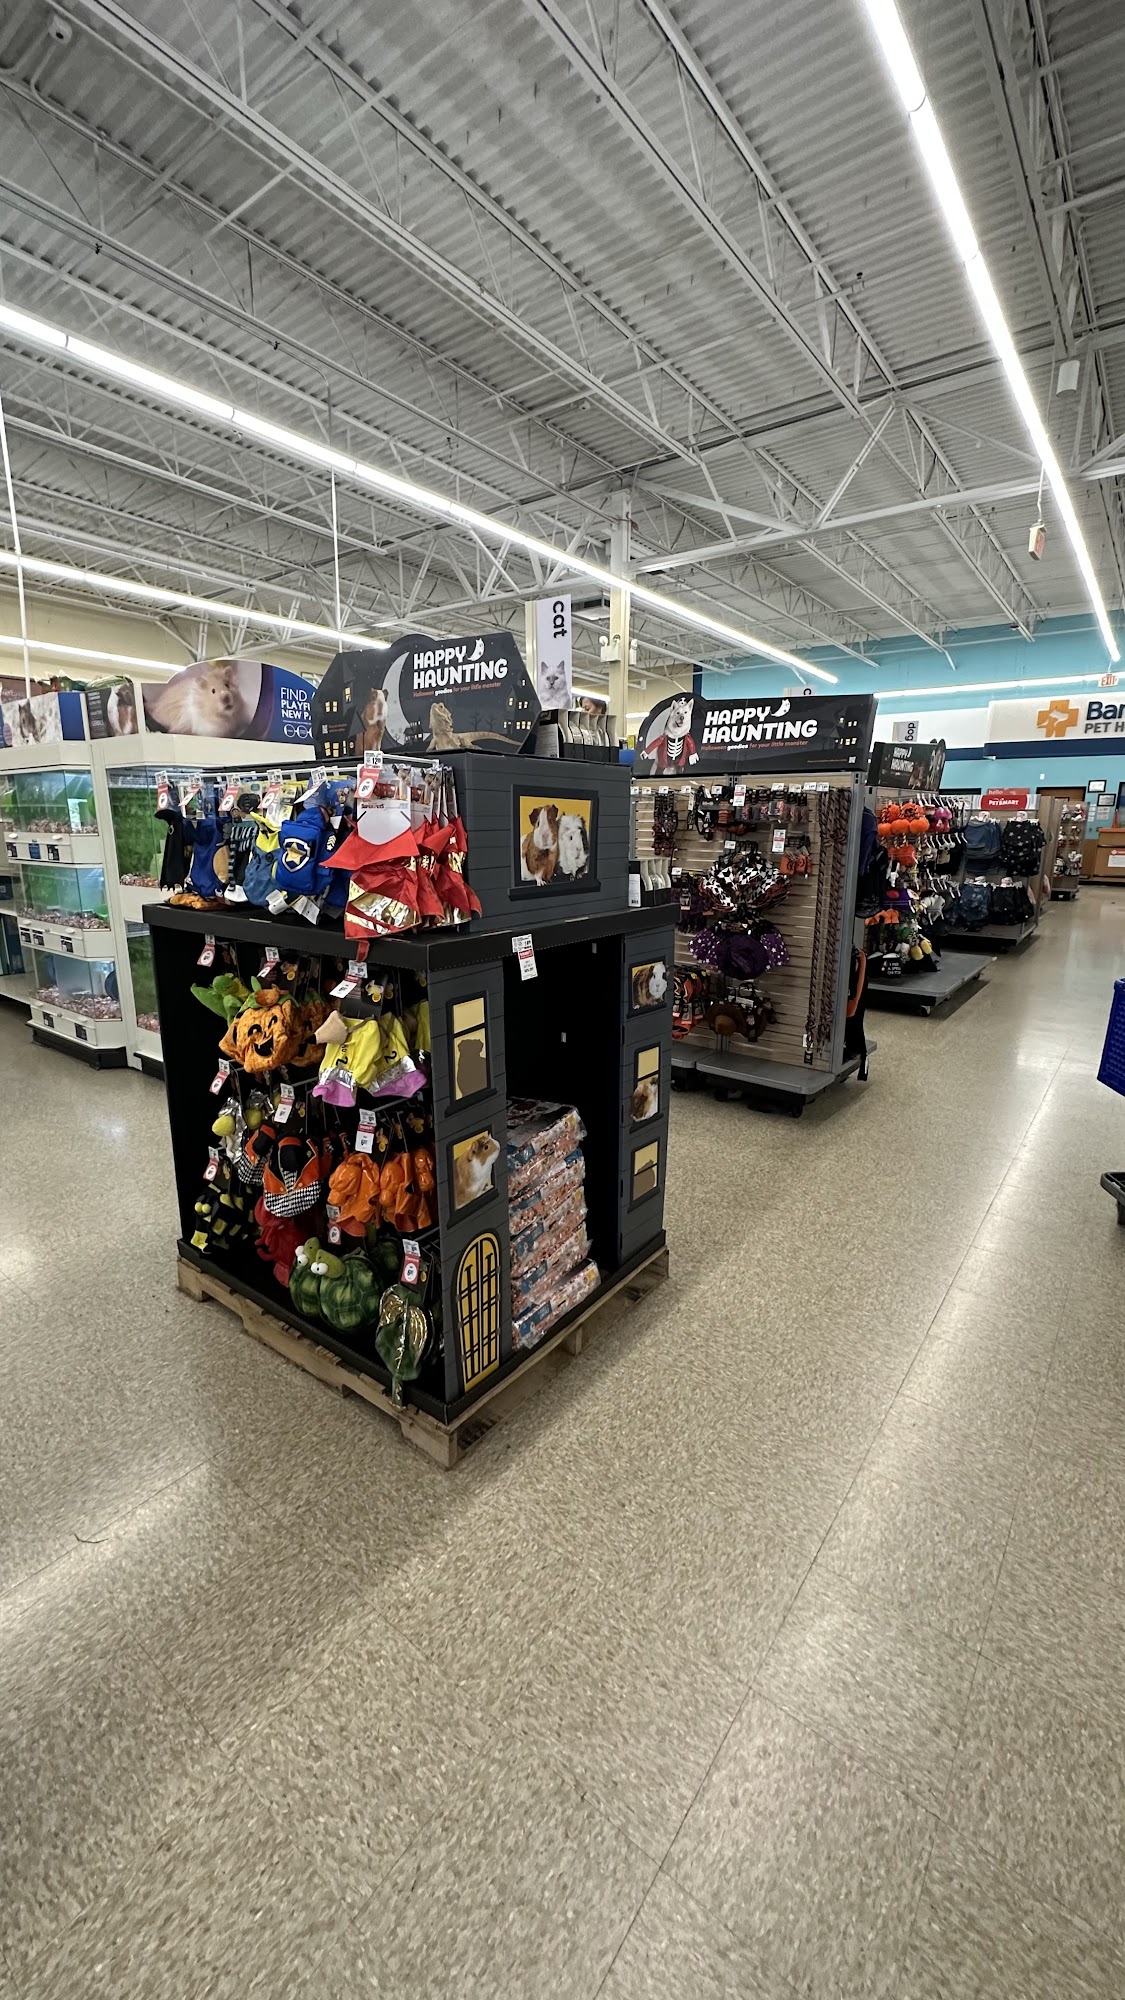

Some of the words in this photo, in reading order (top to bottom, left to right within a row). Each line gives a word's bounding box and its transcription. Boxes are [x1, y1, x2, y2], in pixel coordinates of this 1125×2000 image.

[552, 600, 567, 638] cat
[413, 645, 467, 670] HAPPY
[413, 658, 508, 690] HAUNTING
[281, 687, 308, 702] FIND
[281, 709, 301, 720] NEW
[705, 706, 771, 726] HAPPY
[701, 719, 818, 744] HAUNTING
[905, 722, 916, 741] dog
[1084, 722, 1111, 734] PET
[1114, 721, 1125, 732] H
[383, 1050, 397, 1064] 2
